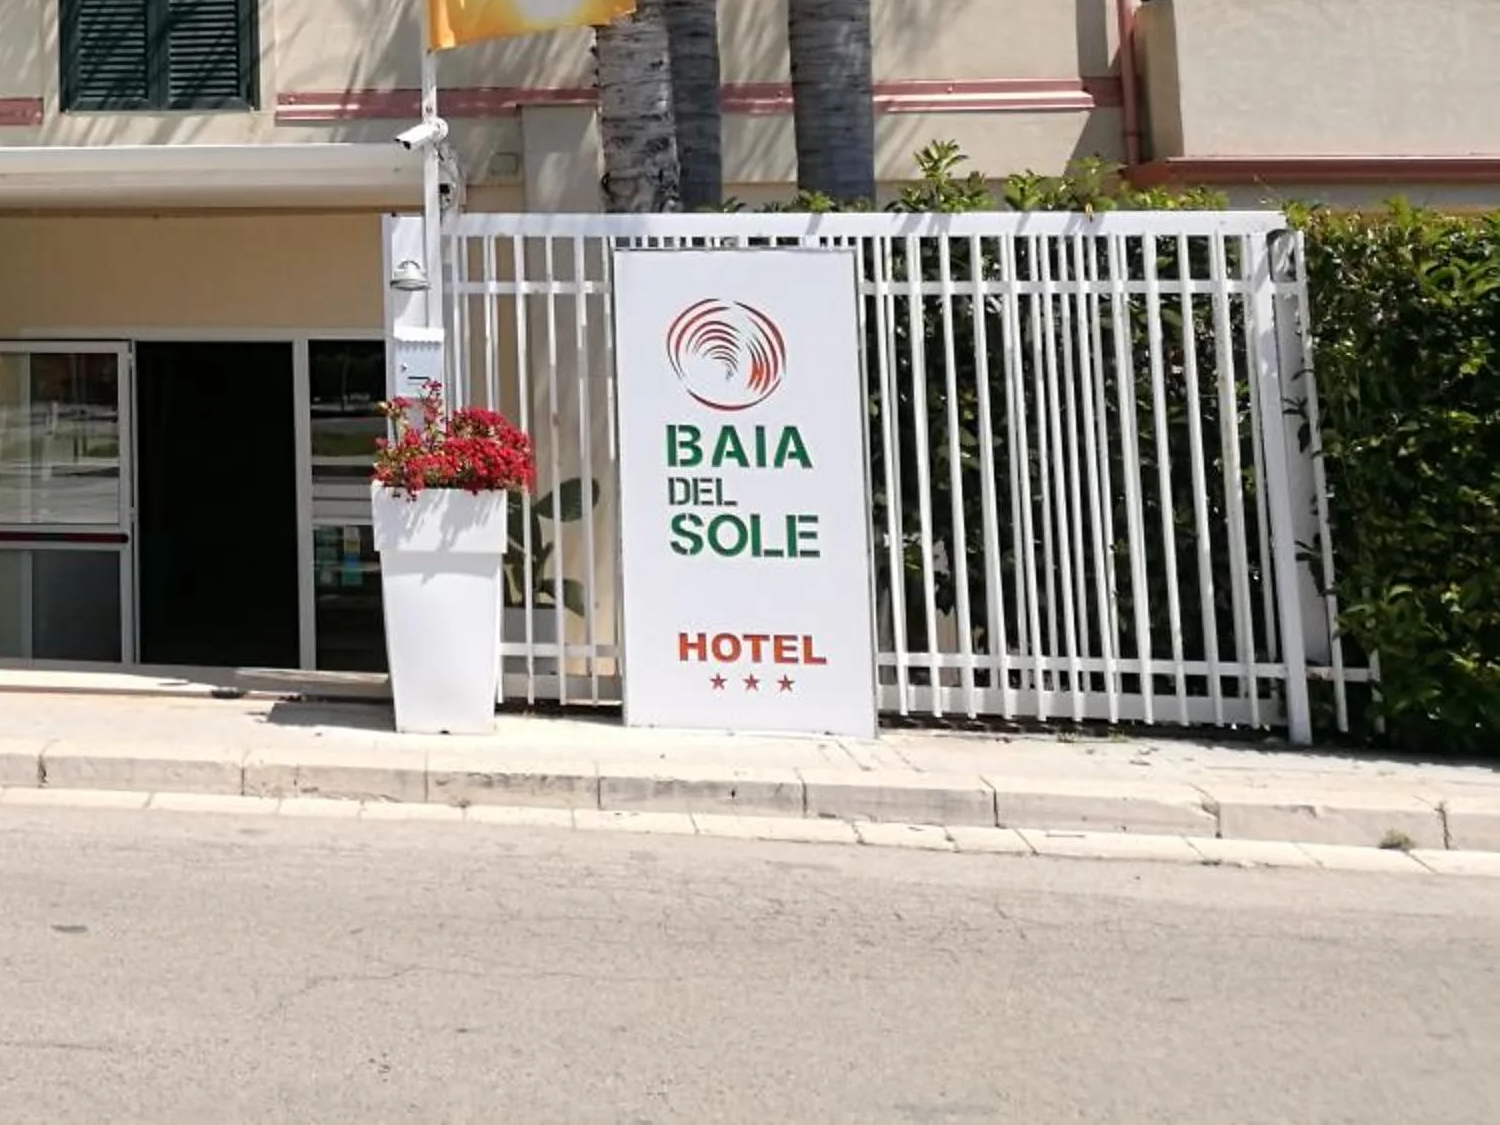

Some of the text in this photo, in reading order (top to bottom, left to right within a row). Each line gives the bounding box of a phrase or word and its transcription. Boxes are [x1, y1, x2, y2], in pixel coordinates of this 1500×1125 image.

[666, 424, 813, 468] BAIA
[668, 476, 738, 506] DEL
[670, 513, 820, 558] SOLE
[678, 632, 827, 665] HOTEL
